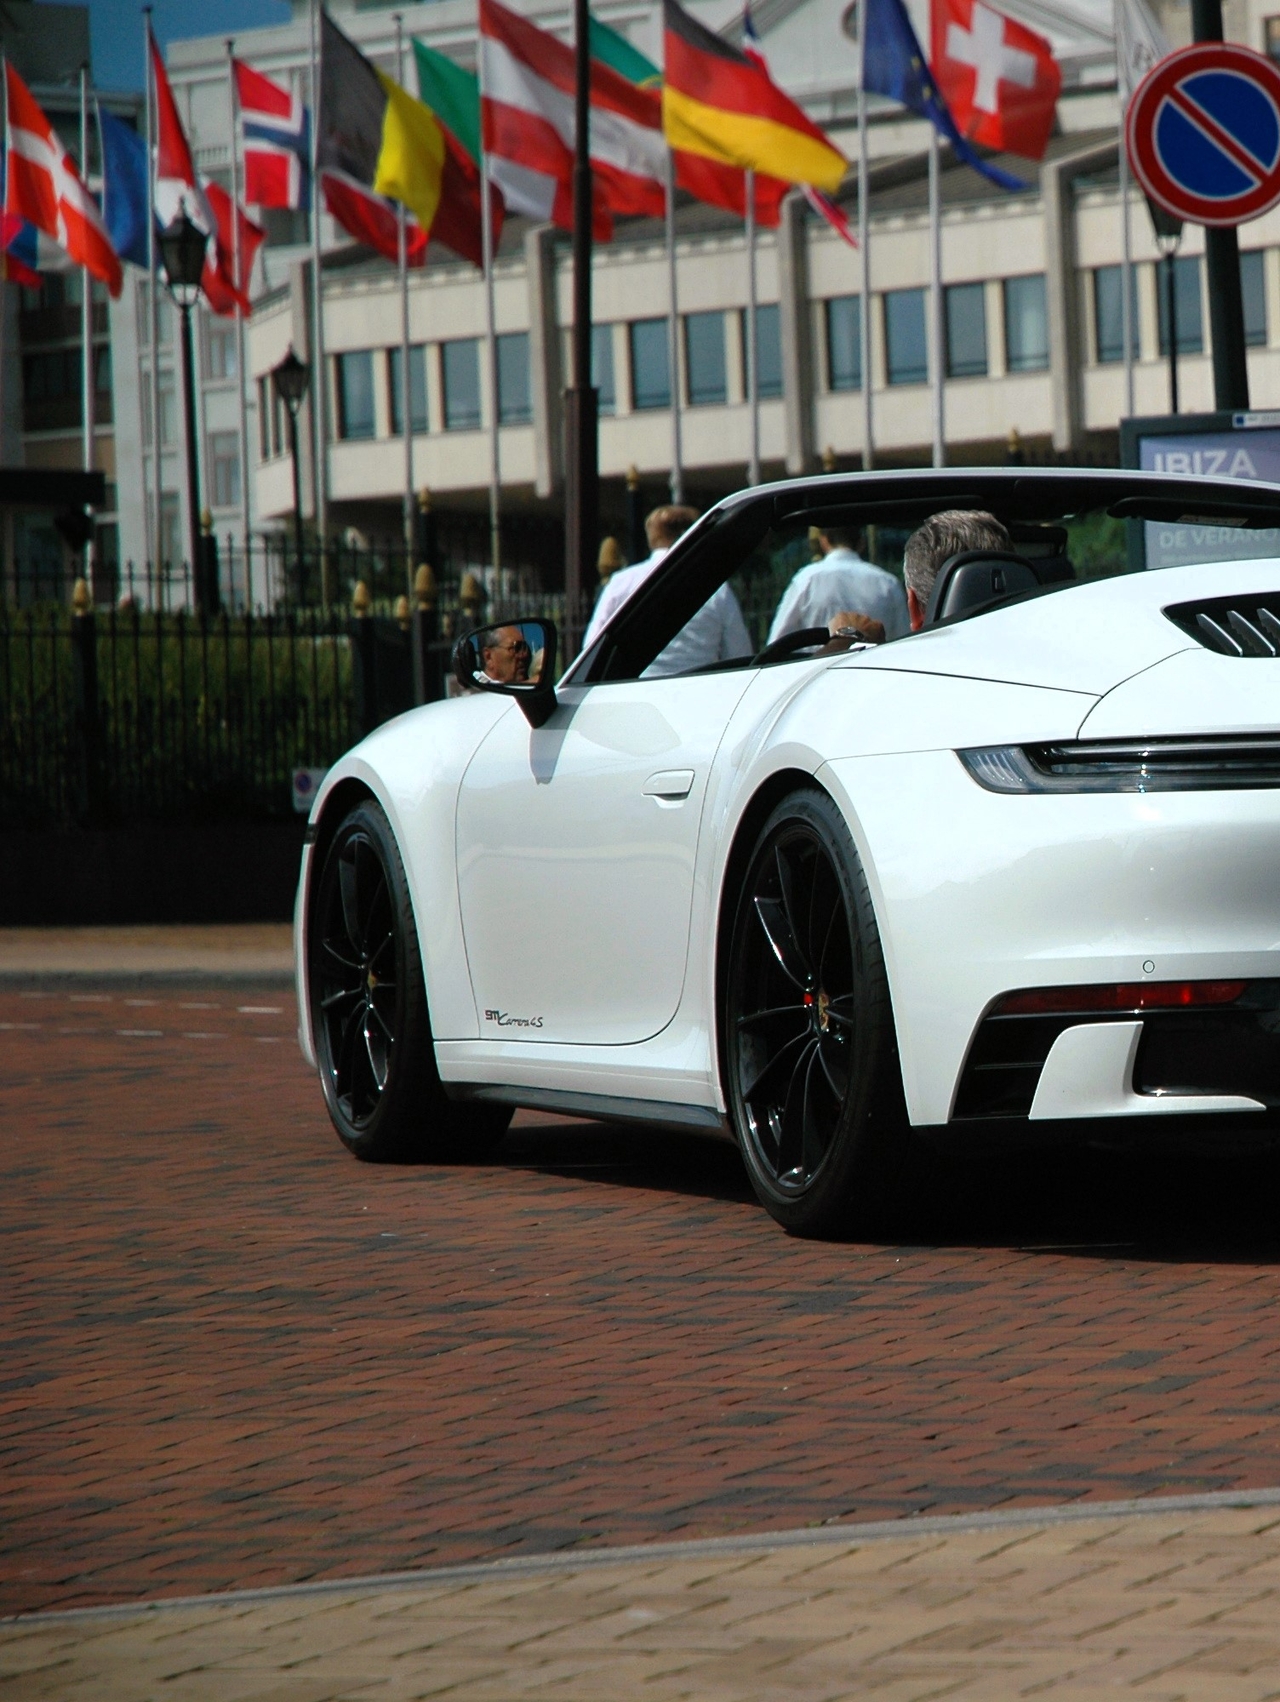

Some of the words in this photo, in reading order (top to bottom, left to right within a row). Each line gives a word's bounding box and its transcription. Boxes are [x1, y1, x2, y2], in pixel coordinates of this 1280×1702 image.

[1154, 448, 1257, 477] IBIZA
[1160, 530, 1187, 548] DE
[1192, 526, 1277, 546] VERANO
